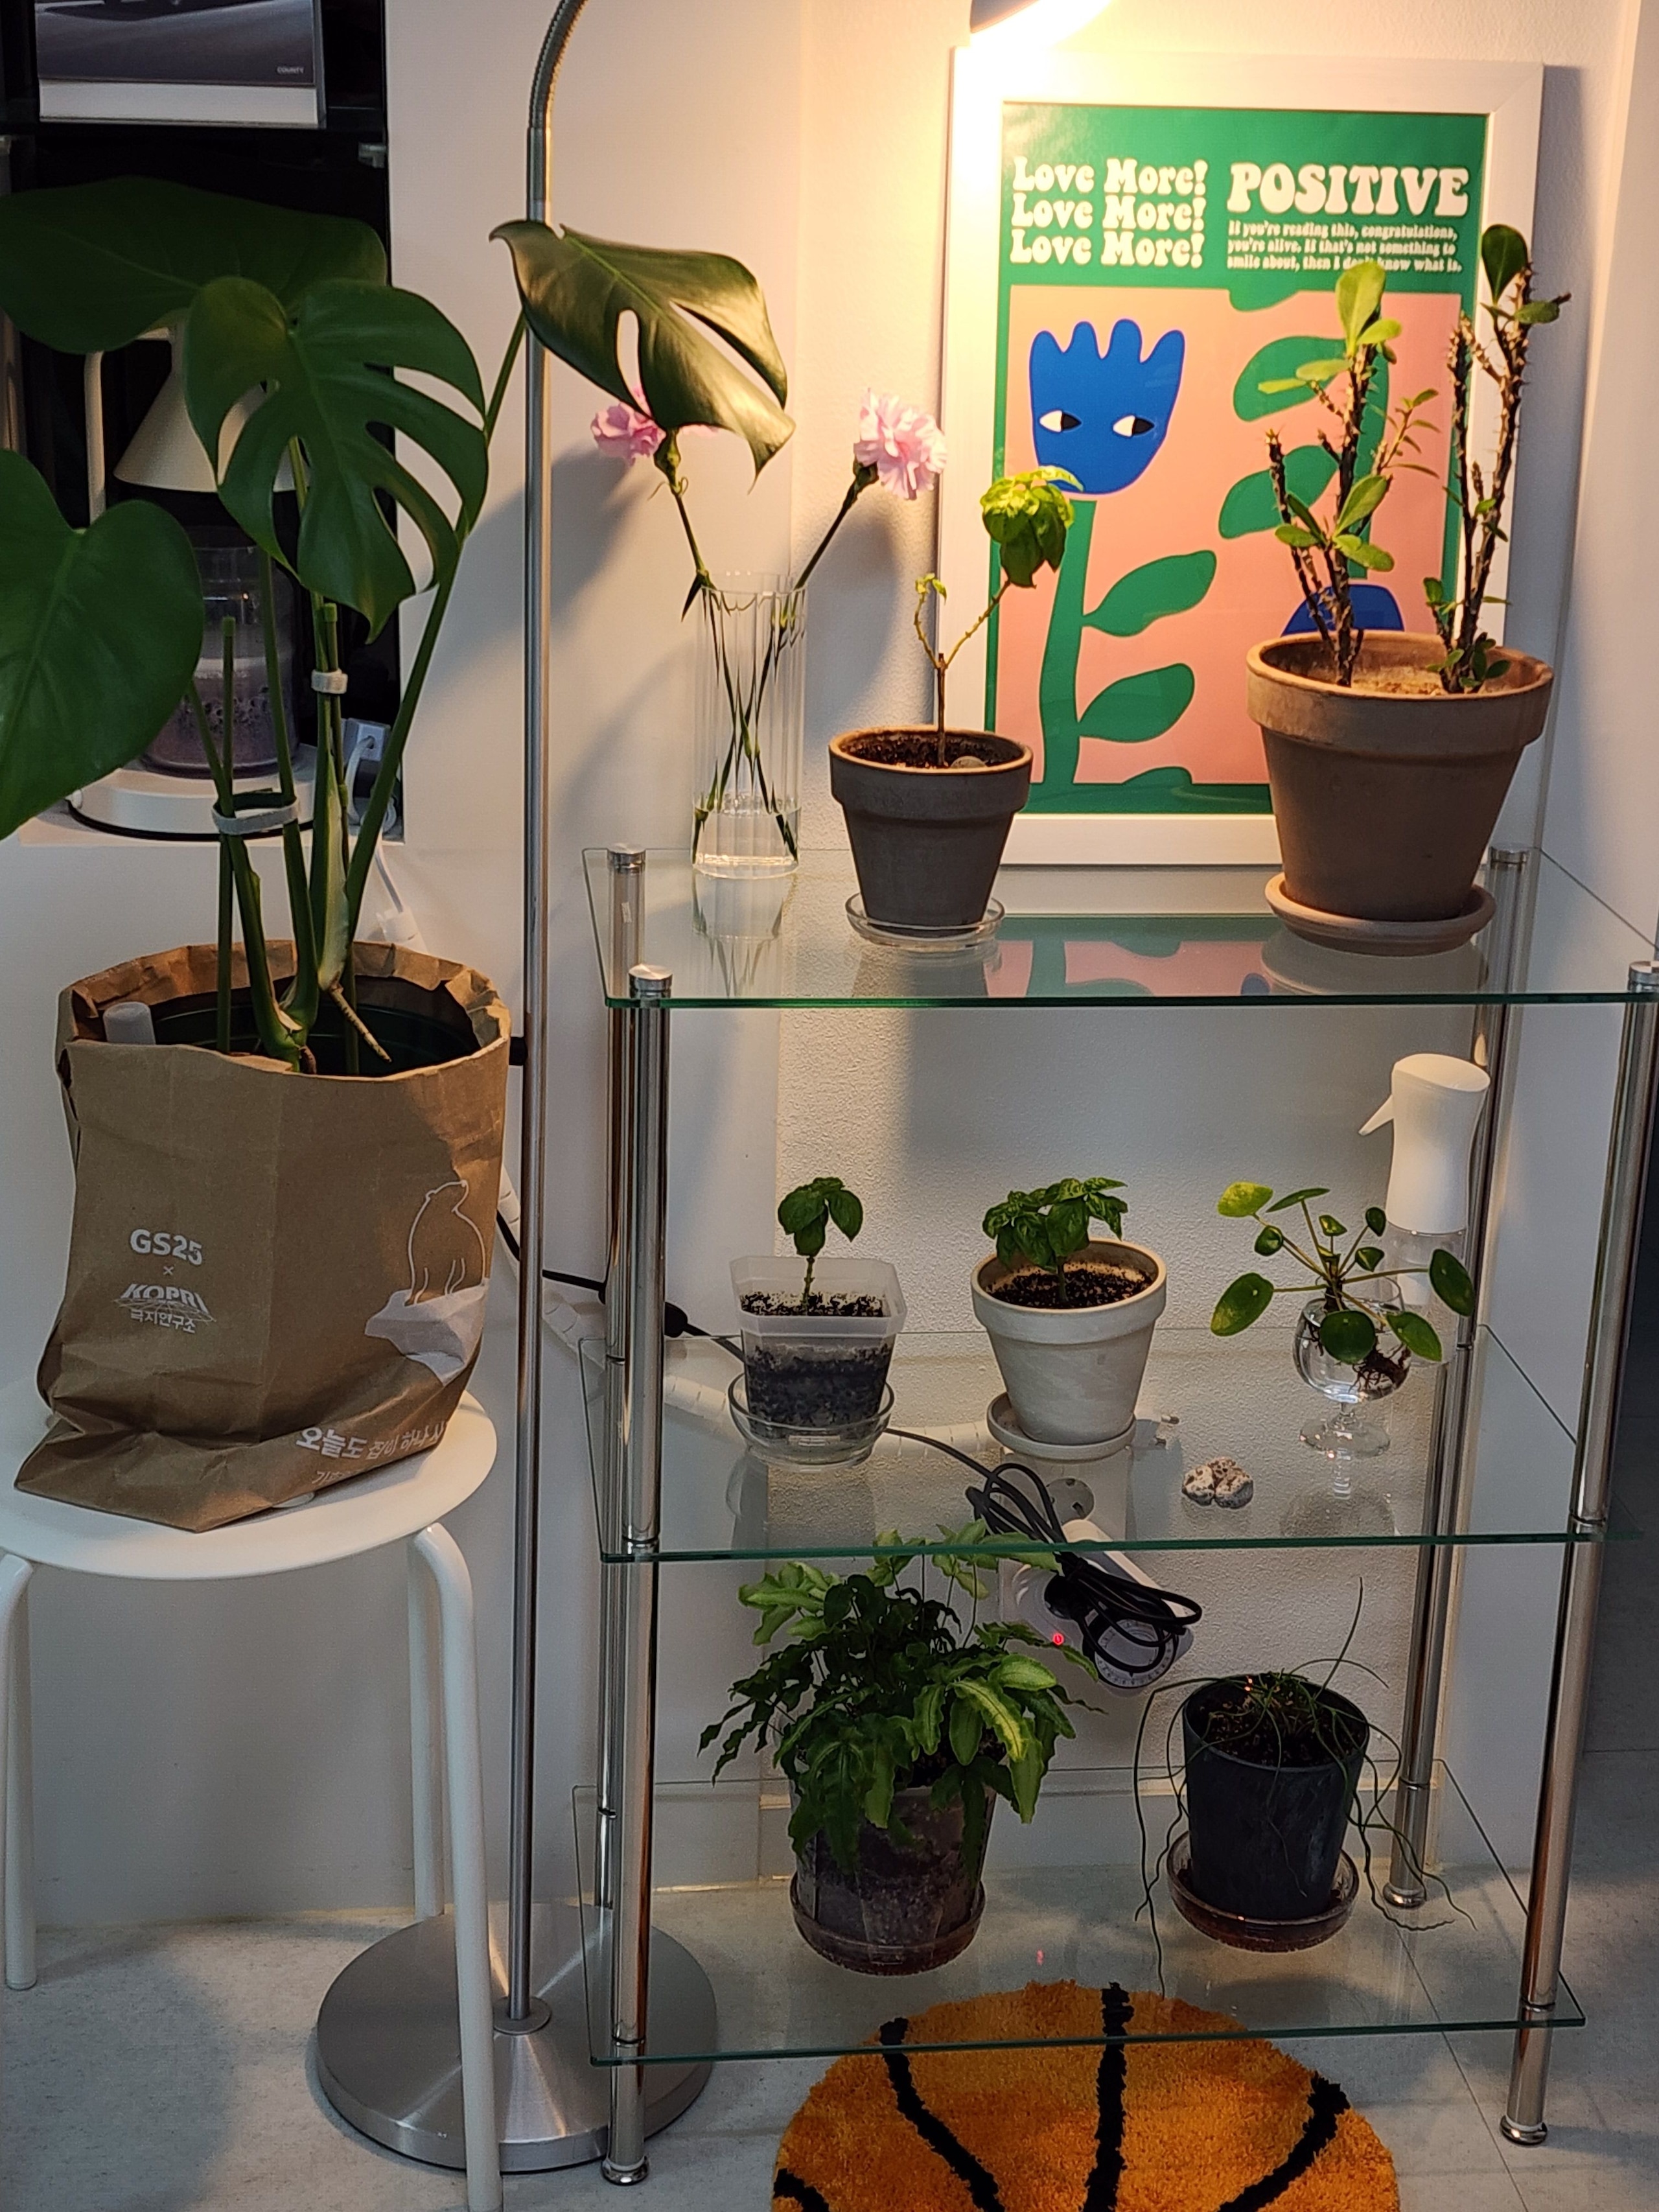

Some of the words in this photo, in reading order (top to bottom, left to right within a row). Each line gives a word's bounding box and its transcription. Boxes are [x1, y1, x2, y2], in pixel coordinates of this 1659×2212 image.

[1012, 156, 1095, 193] Love
[1104, 157, 1208, 196] More!
[1227, 161, 1469, 217] POSITIVE
[1011, 192, 1093, 229] Love
[1102, 194, 1207, 232] More!
[1227, 237, 1265, 254] you're
[1356, 240, 1377, 255] not
[1379, 240, 1441, 257] something
[1443, 242, 1456, 256] to
[1243, 220, 1281, 237] you're
[1282, 222, 1328, 239] reading
[1331, 222, 1359, 240] this,
[1361, 224, 1458, 242] congratulations,
[1010, 228, 1092, 265] Love
[1101, 231, 1205, 268] More!
[1227, 254, 1260, 270] smile
[1262, 254, 1300, 273] about,
[1303, 255, 1331, 270] then
[1413, 258, 1444, 273] what
[130, 1229, 203, 1265] GS25
[121, 1283, 209, 1316] KOPRI
[130, 1309, 196, 1334] 극지연구소
[296, 1426, 367, 1459] 오늘도
